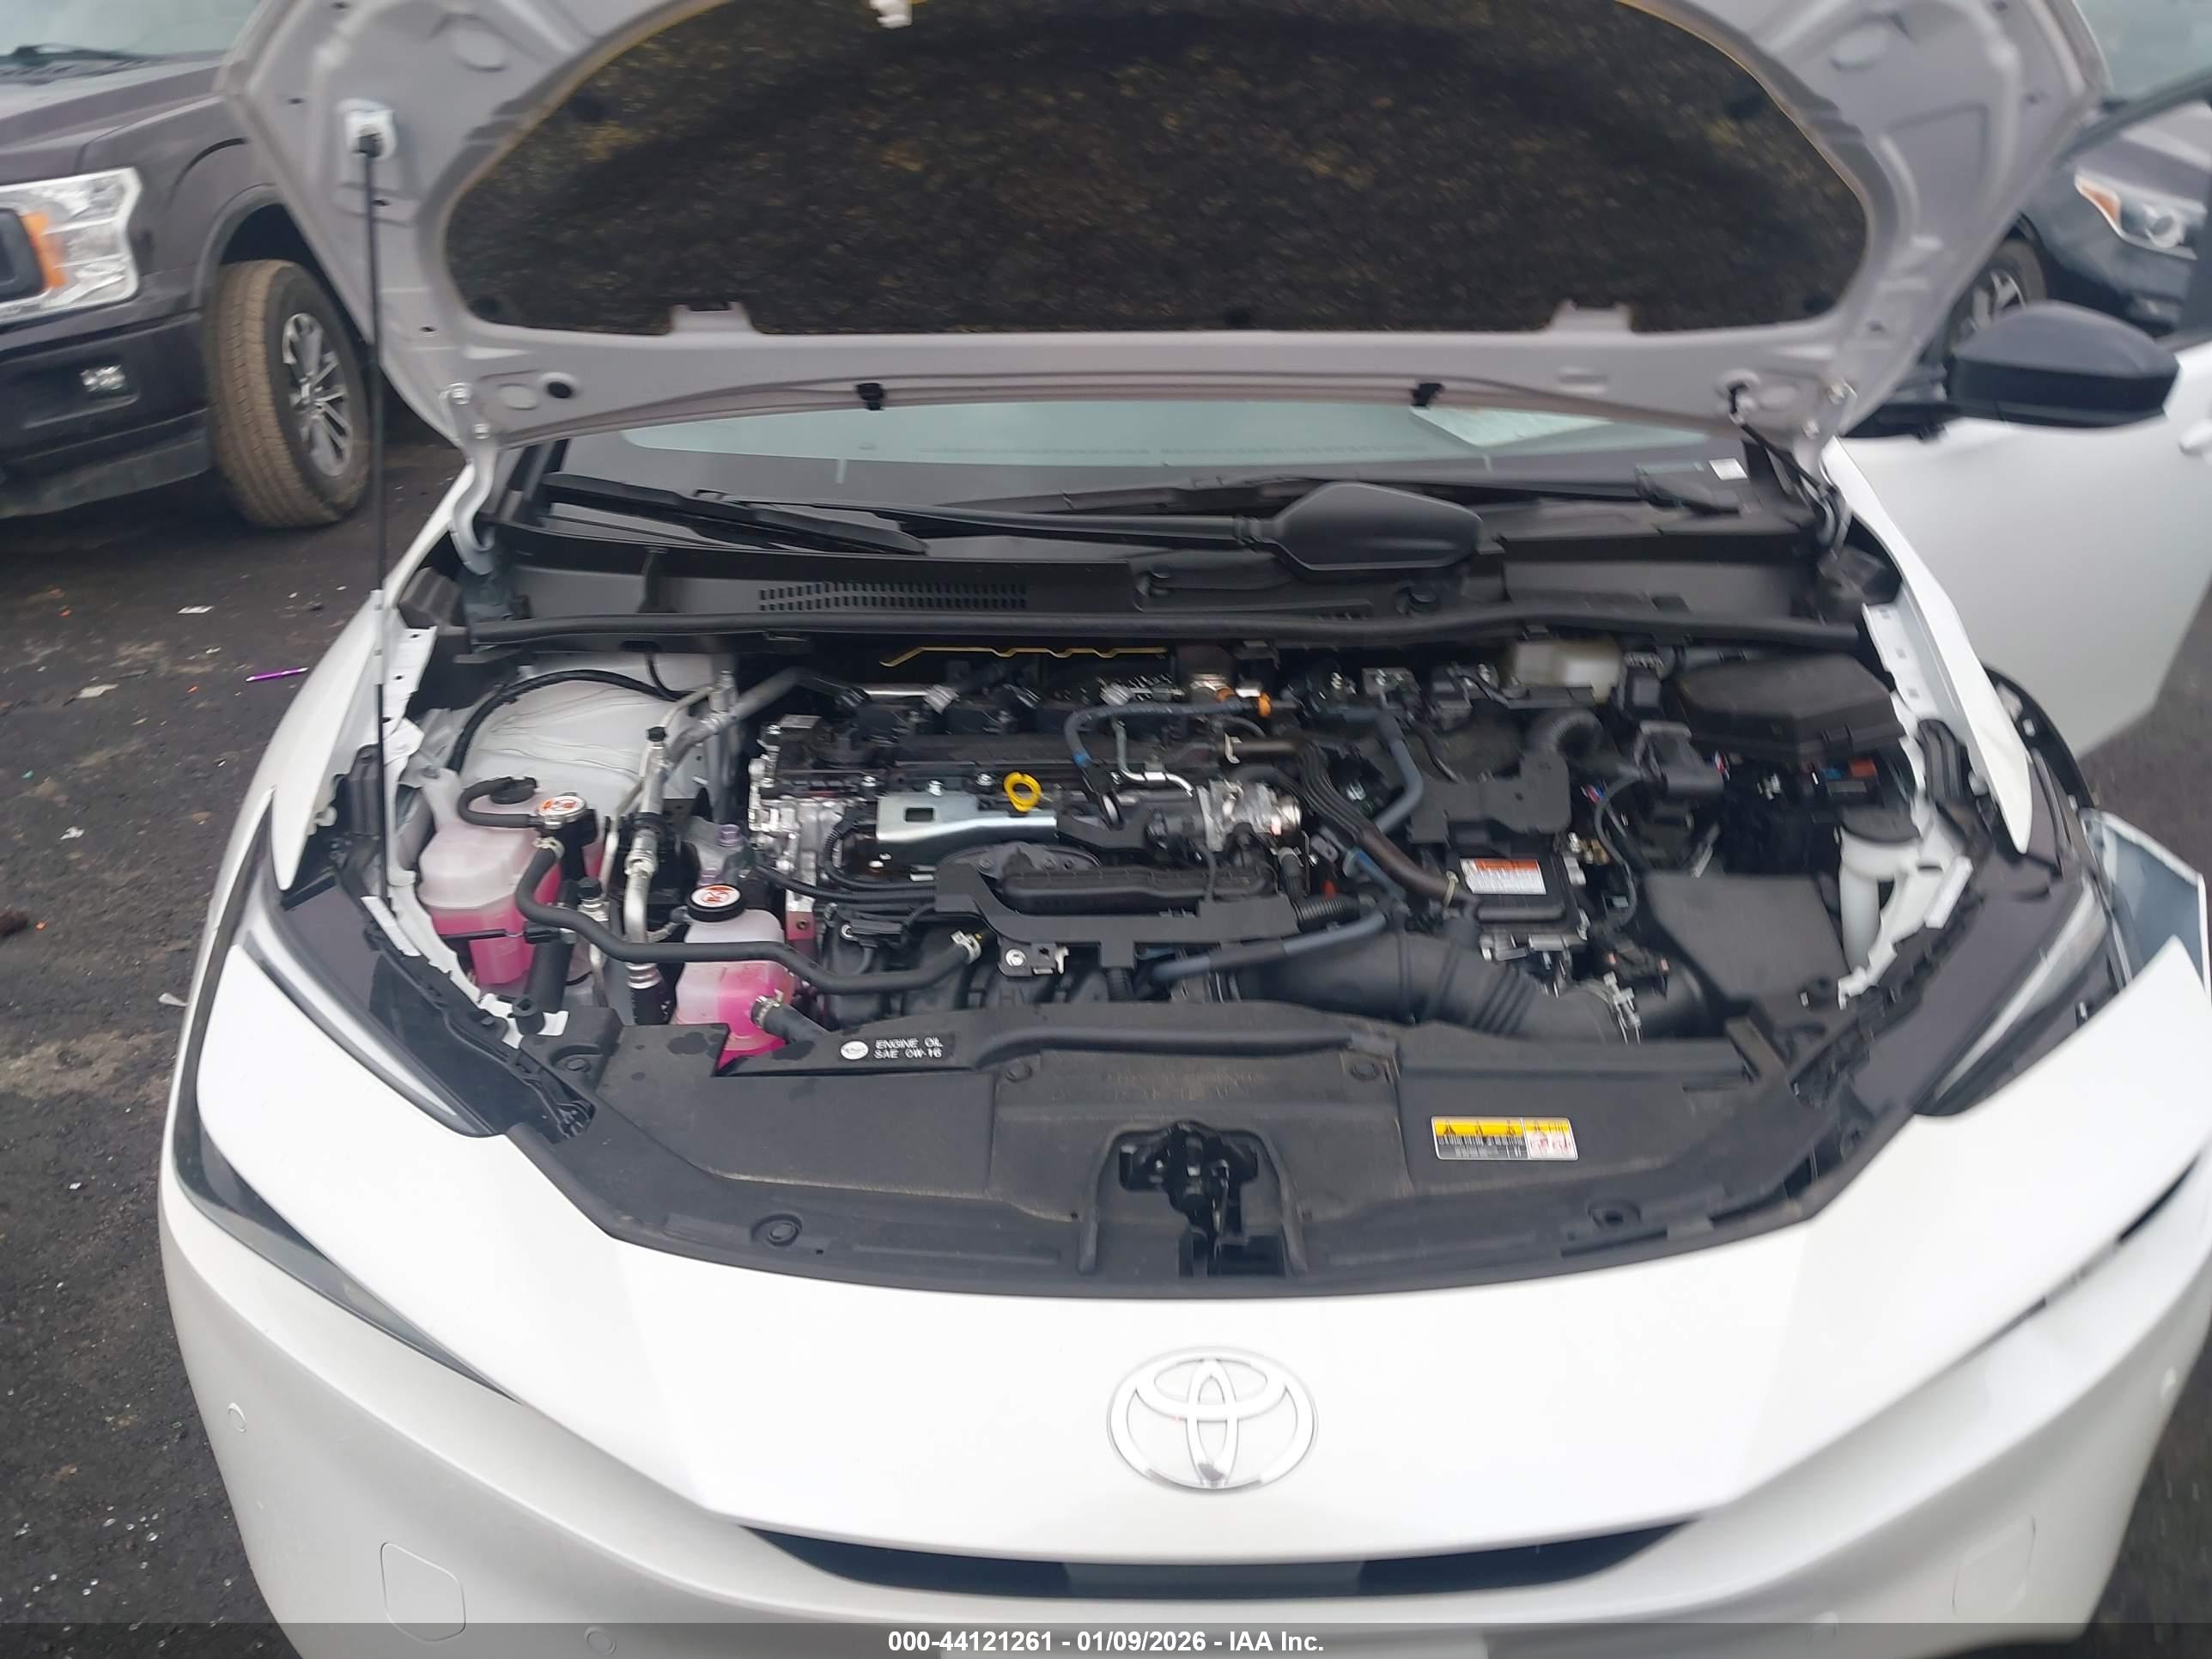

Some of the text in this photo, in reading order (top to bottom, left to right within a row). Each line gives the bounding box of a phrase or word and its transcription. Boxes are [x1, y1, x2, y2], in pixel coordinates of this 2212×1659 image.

[875, 1036, 944, 1048] ENGINE OIL
[873, 1048, 899, 1059] SAE
